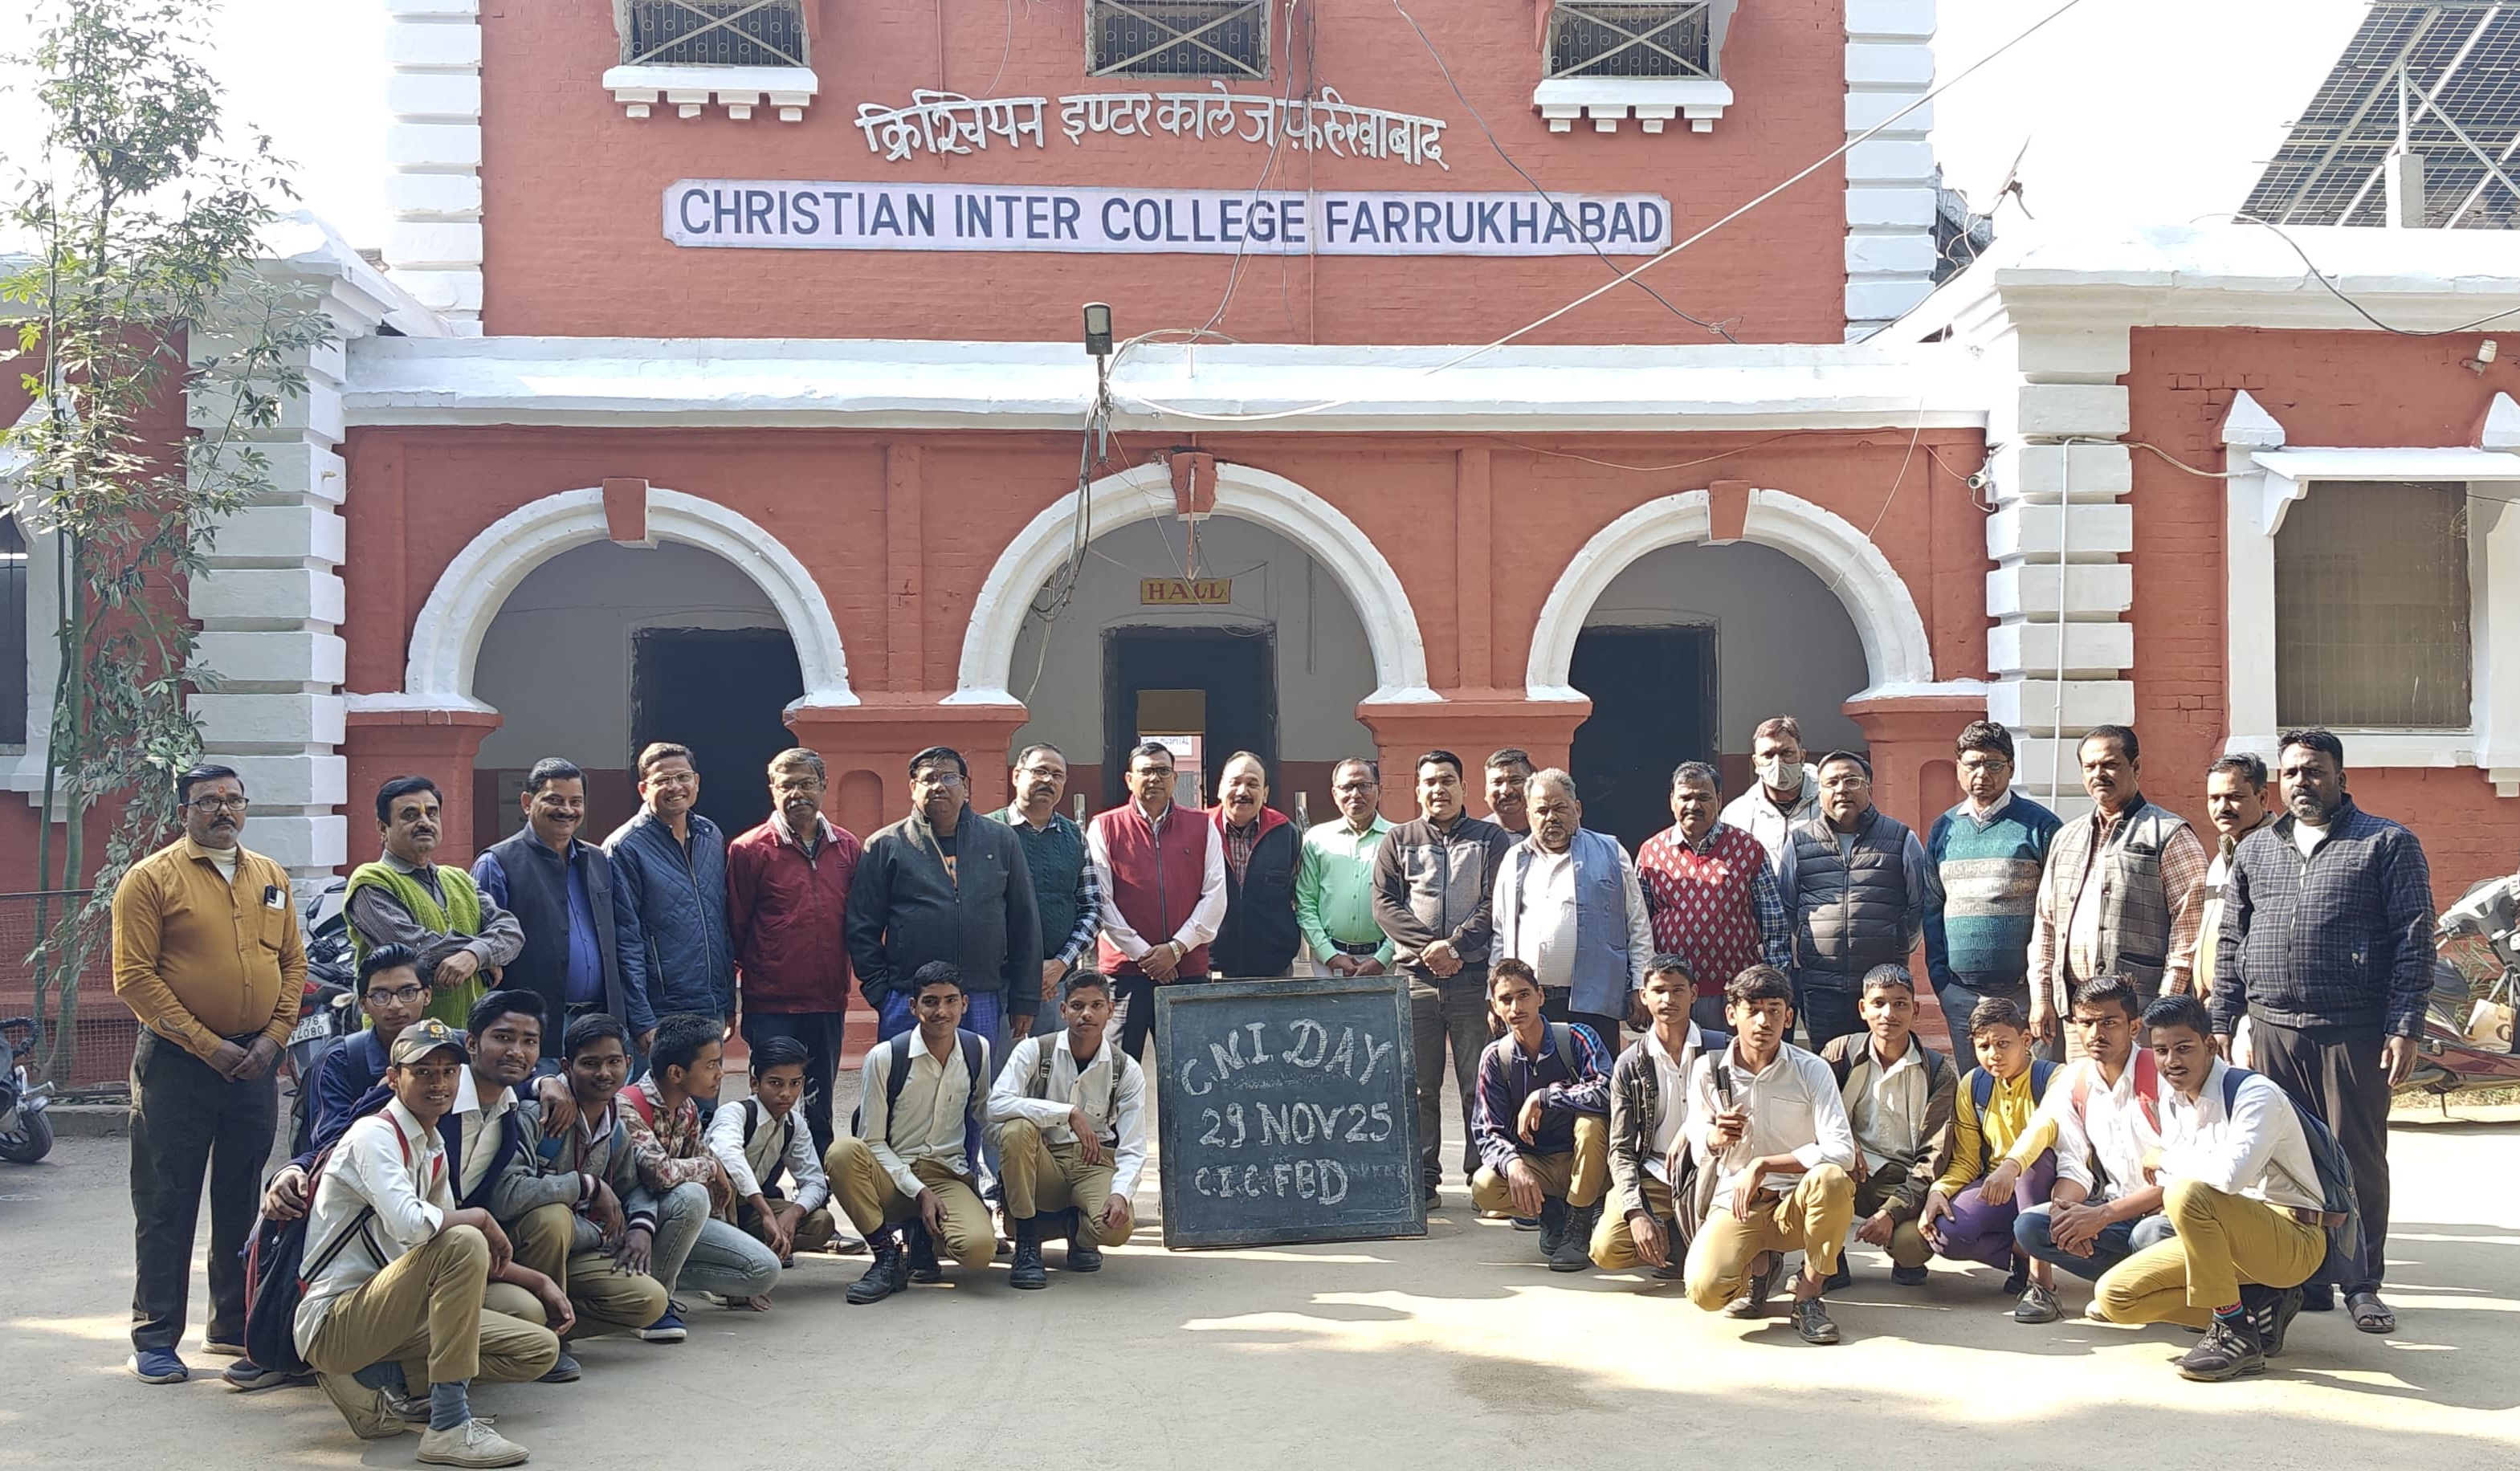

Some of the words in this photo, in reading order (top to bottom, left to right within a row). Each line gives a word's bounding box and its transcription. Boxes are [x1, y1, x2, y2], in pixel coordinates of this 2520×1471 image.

[1058, 92, 1154, 145] इण्टर
[680, 189, 935, 237] CHRISTIAN
[955, 194, 1082, 240] INTER
[1101, 198, 1306, 243] COLLEGE
[1326, 201, 1664, 244] FARRUKHABAD
[1148, 583, 1225, 600] HALL
[1282, 1018, 1393, 1085] DAY
[1199, 1102, 1246, 1147] 29
